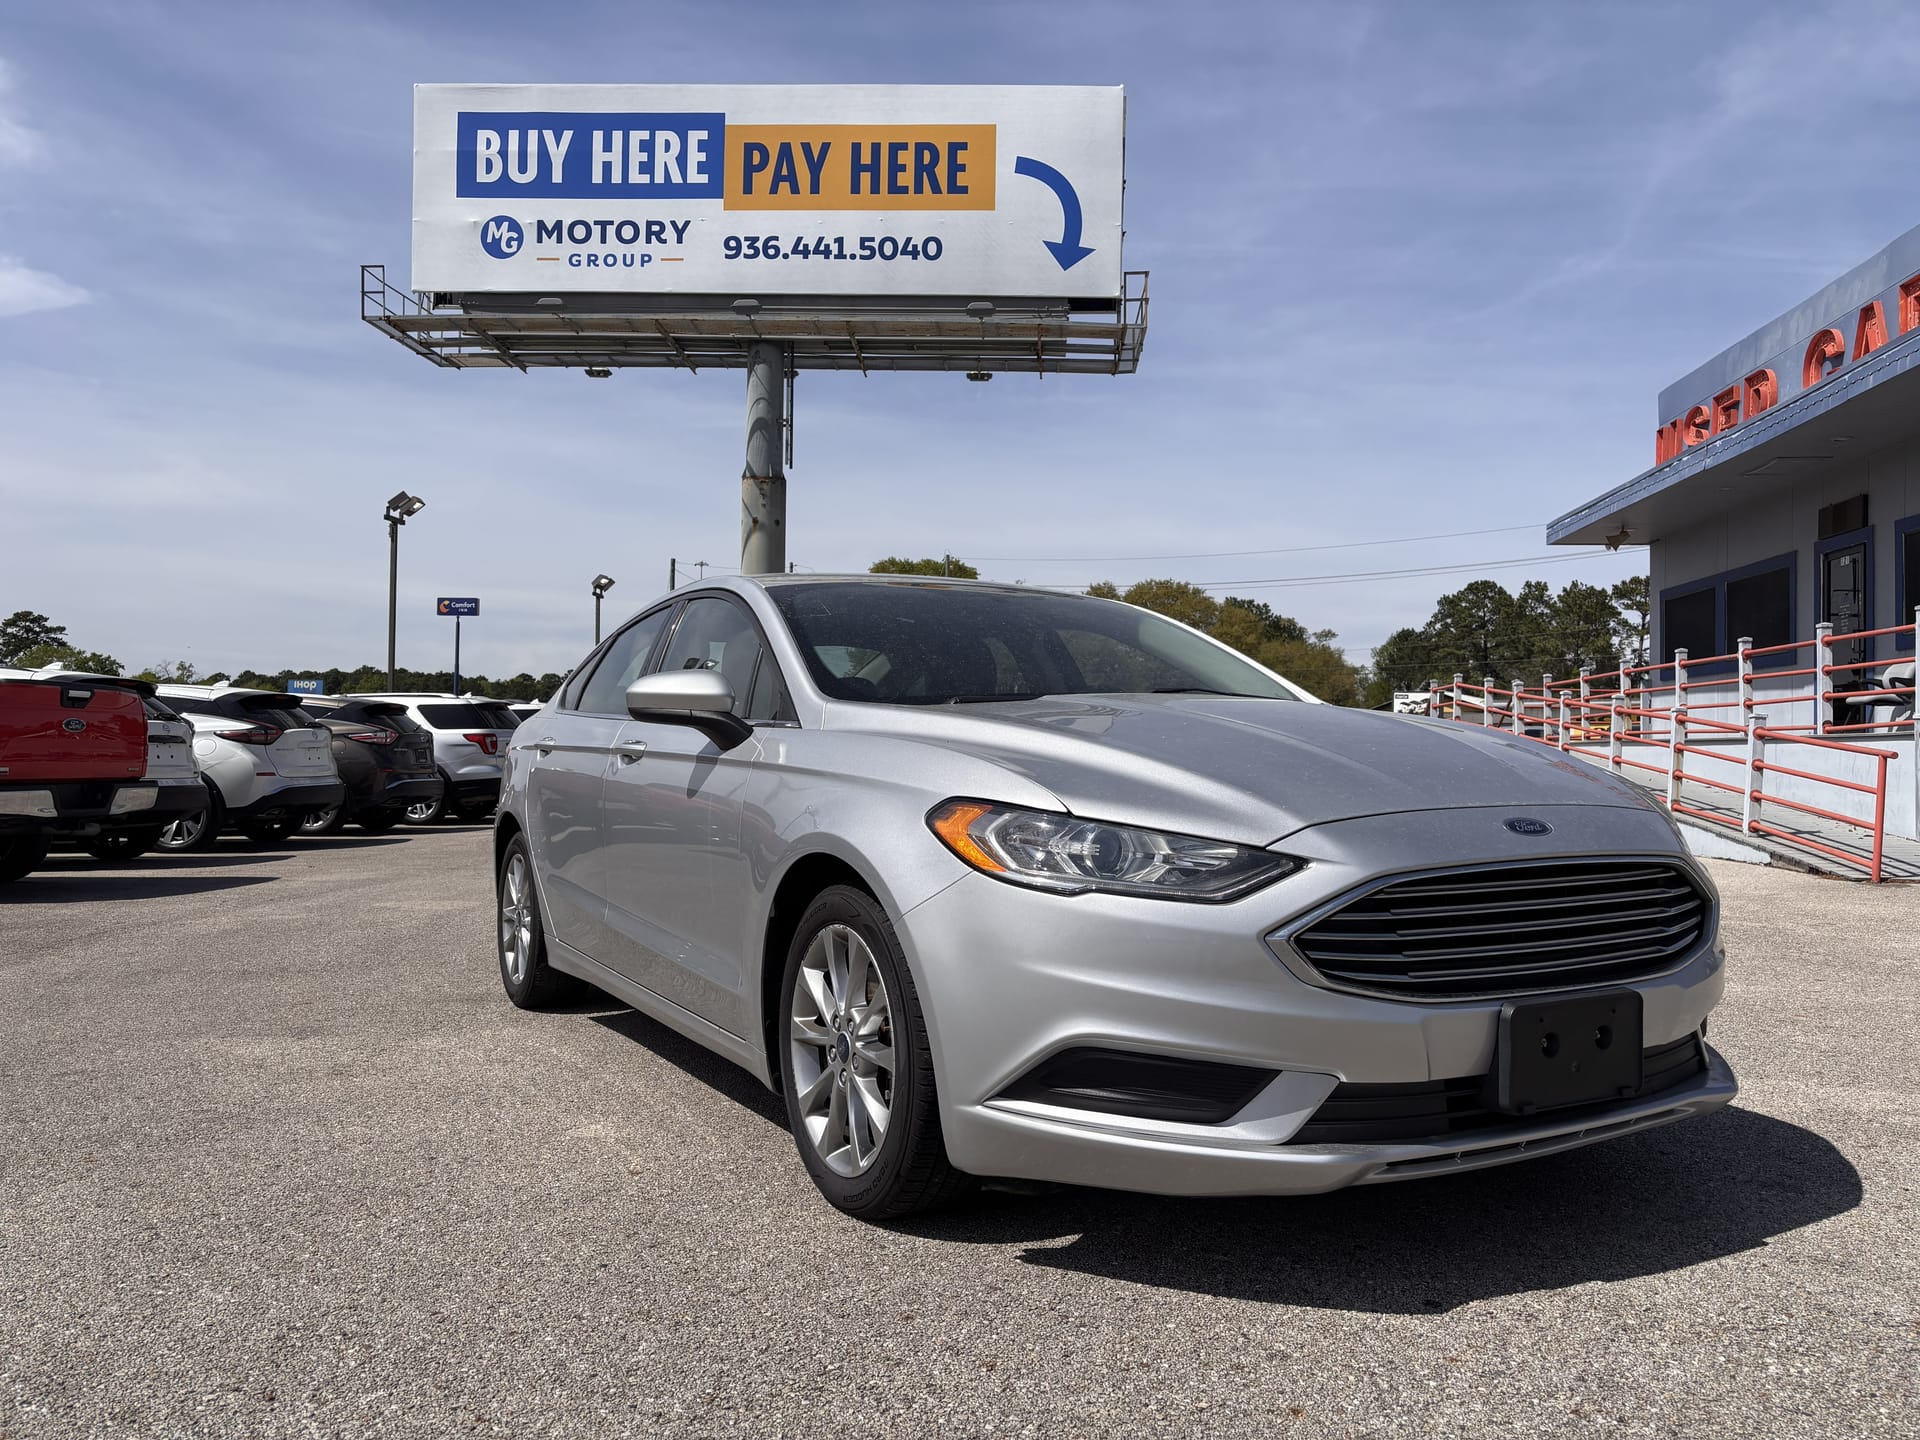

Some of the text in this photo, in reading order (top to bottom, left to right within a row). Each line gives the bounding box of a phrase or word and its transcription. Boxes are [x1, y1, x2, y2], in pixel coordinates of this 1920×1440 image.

[475, 129, 709, 185] BUY HERE
[742, 141, 969, 195] PAY HERE
[486, 221, 519, 254] MG
[536, 219, 692, 245] MOTORY
[567, 253, 653, 268] GROUP
[723, 235, 944, 262] 936.441.5040
[1656, 367, 1779, 467] USED
[450, 601, 476, 609] Comfort
